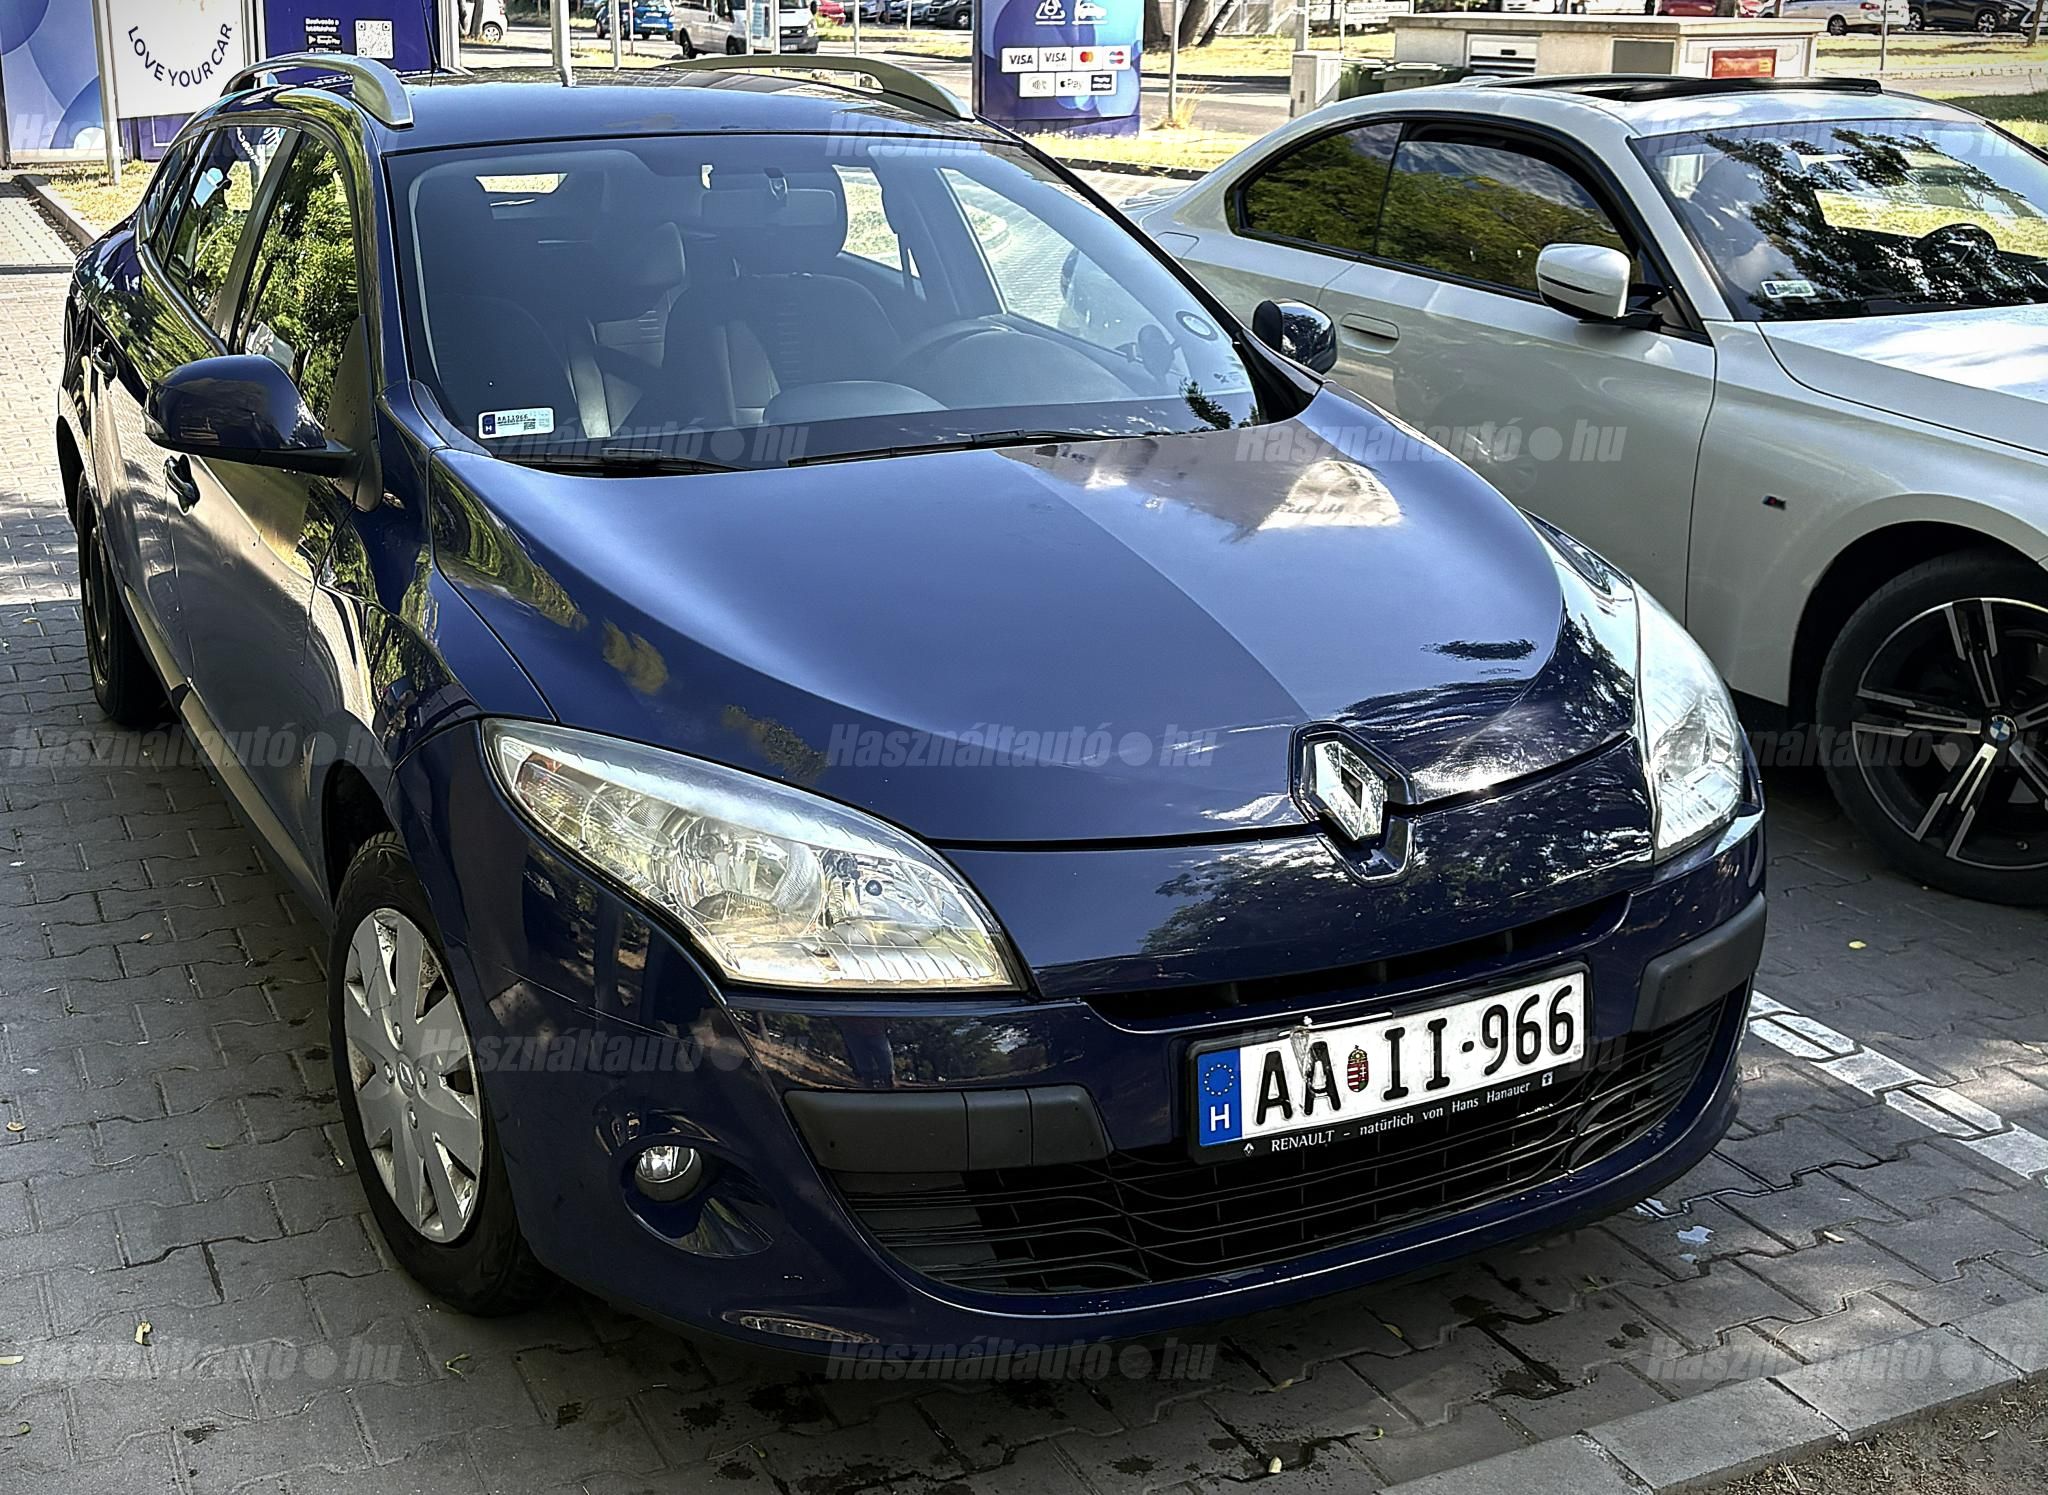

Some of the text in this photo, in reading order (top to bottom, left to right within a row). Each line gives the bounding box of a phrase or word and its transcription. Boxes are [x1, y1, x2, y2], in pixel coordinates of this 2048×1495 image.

[128, 24, 232, 87] LOVE YOUR CAR
[1009, 54, 1033, 64] VISA
[1045, 52, 1067, 62] VISA
[1255, 1040, 1342, 1126] AA
[1209, 1104, 1231, 1132] H
[1271, 1130, 1335, 1152] RENAULT
[1360, 1113, 1414, 1135] natürlich
[1422, 1107, 1444, 1121] von
[1452, 1098, 1479, 1113] Hans
[1486, 1082, 1531, 1104] Hanauer
